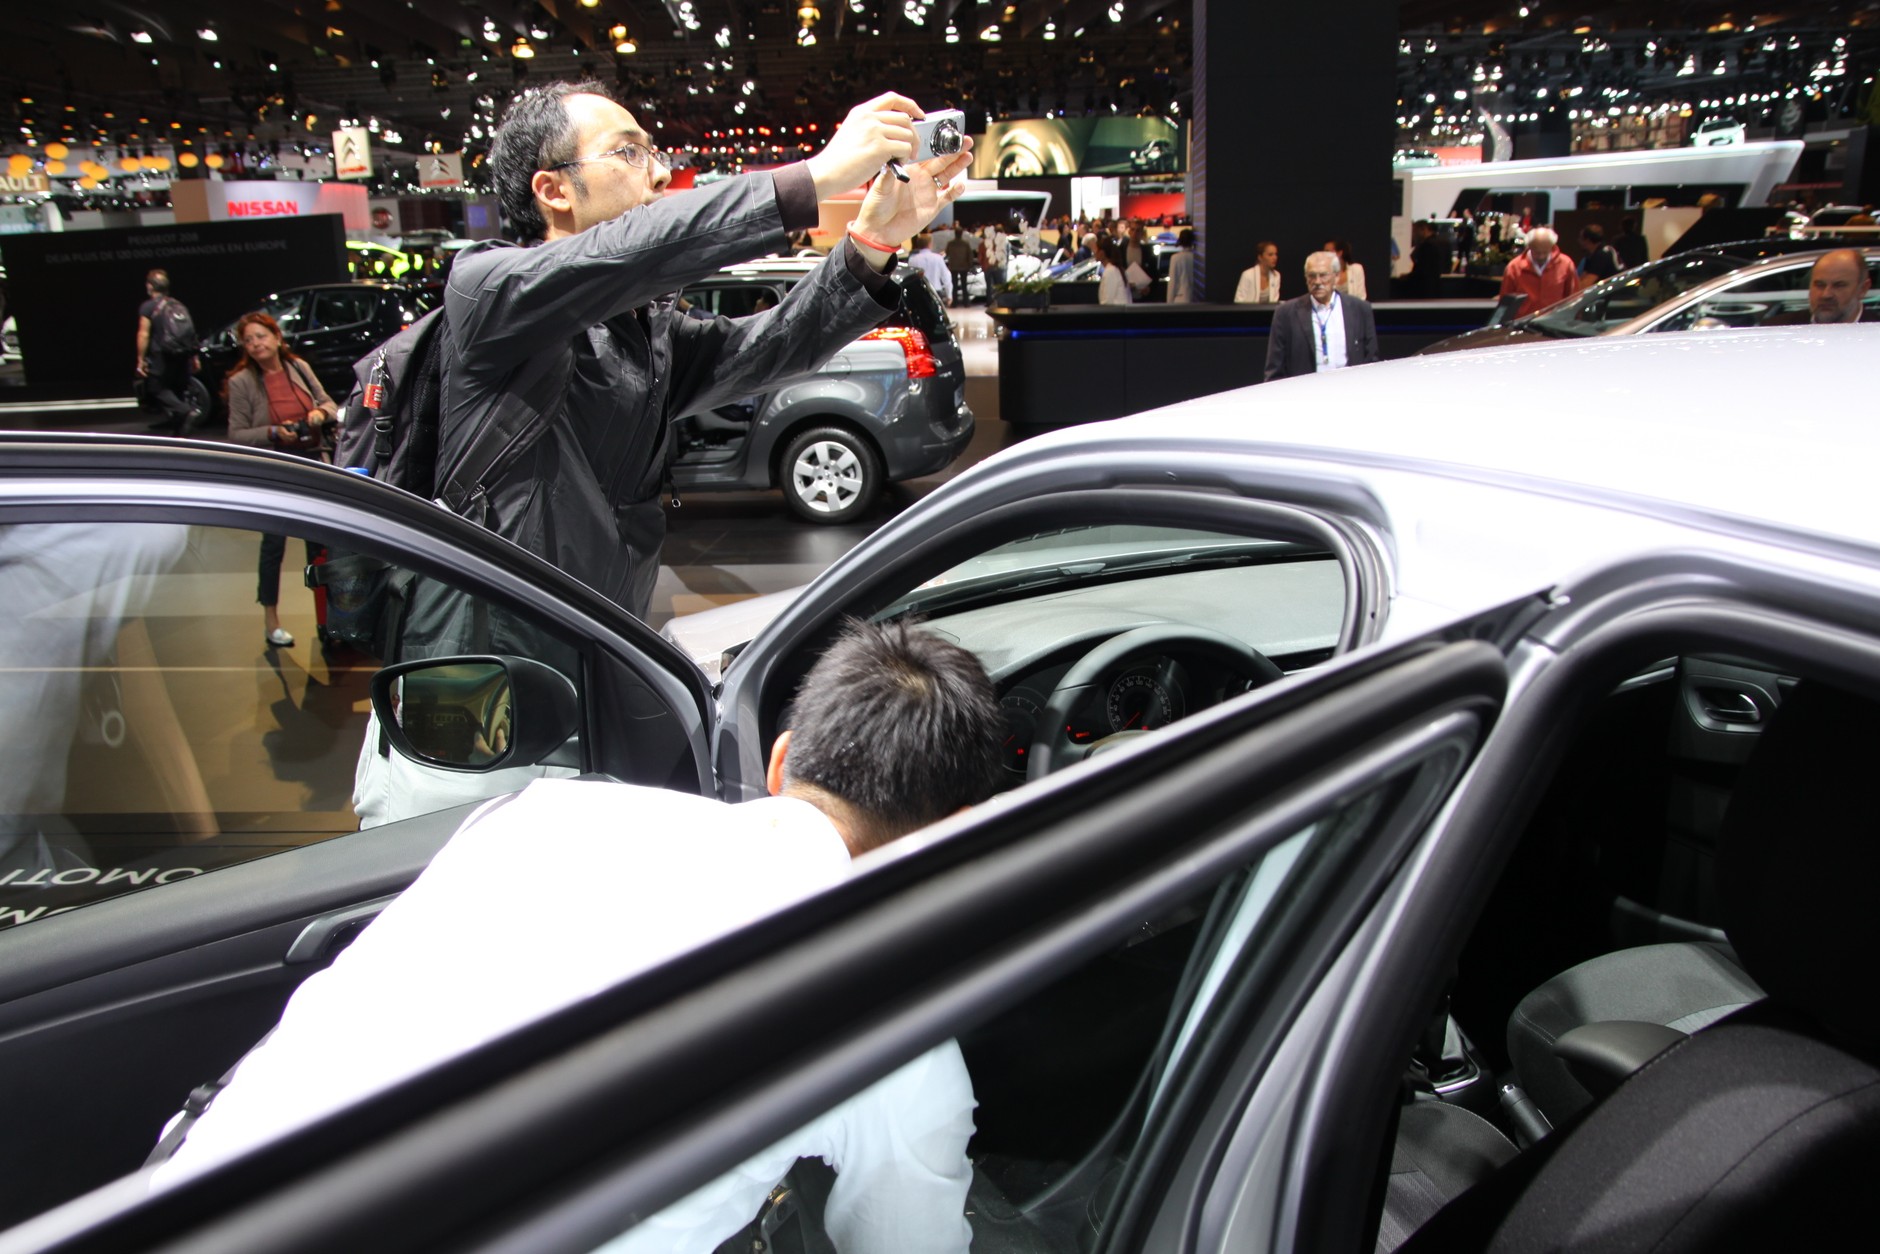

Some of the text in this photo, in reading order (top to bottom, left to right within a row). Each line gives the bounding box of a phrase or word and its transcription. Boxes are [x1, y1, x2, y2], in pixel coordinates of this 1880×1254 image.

[227, 200, 299, 217] NISSAN
[127, 233, 177, 245] PEUGEOT
[72, 251, 98, 262] PLUS
[99, 250, 113, 260] DE
[155, 243, 225, 257] COMMANDES
[227, 242, 242, 253] EN
[244, 240, 288, 252] EUROPE
